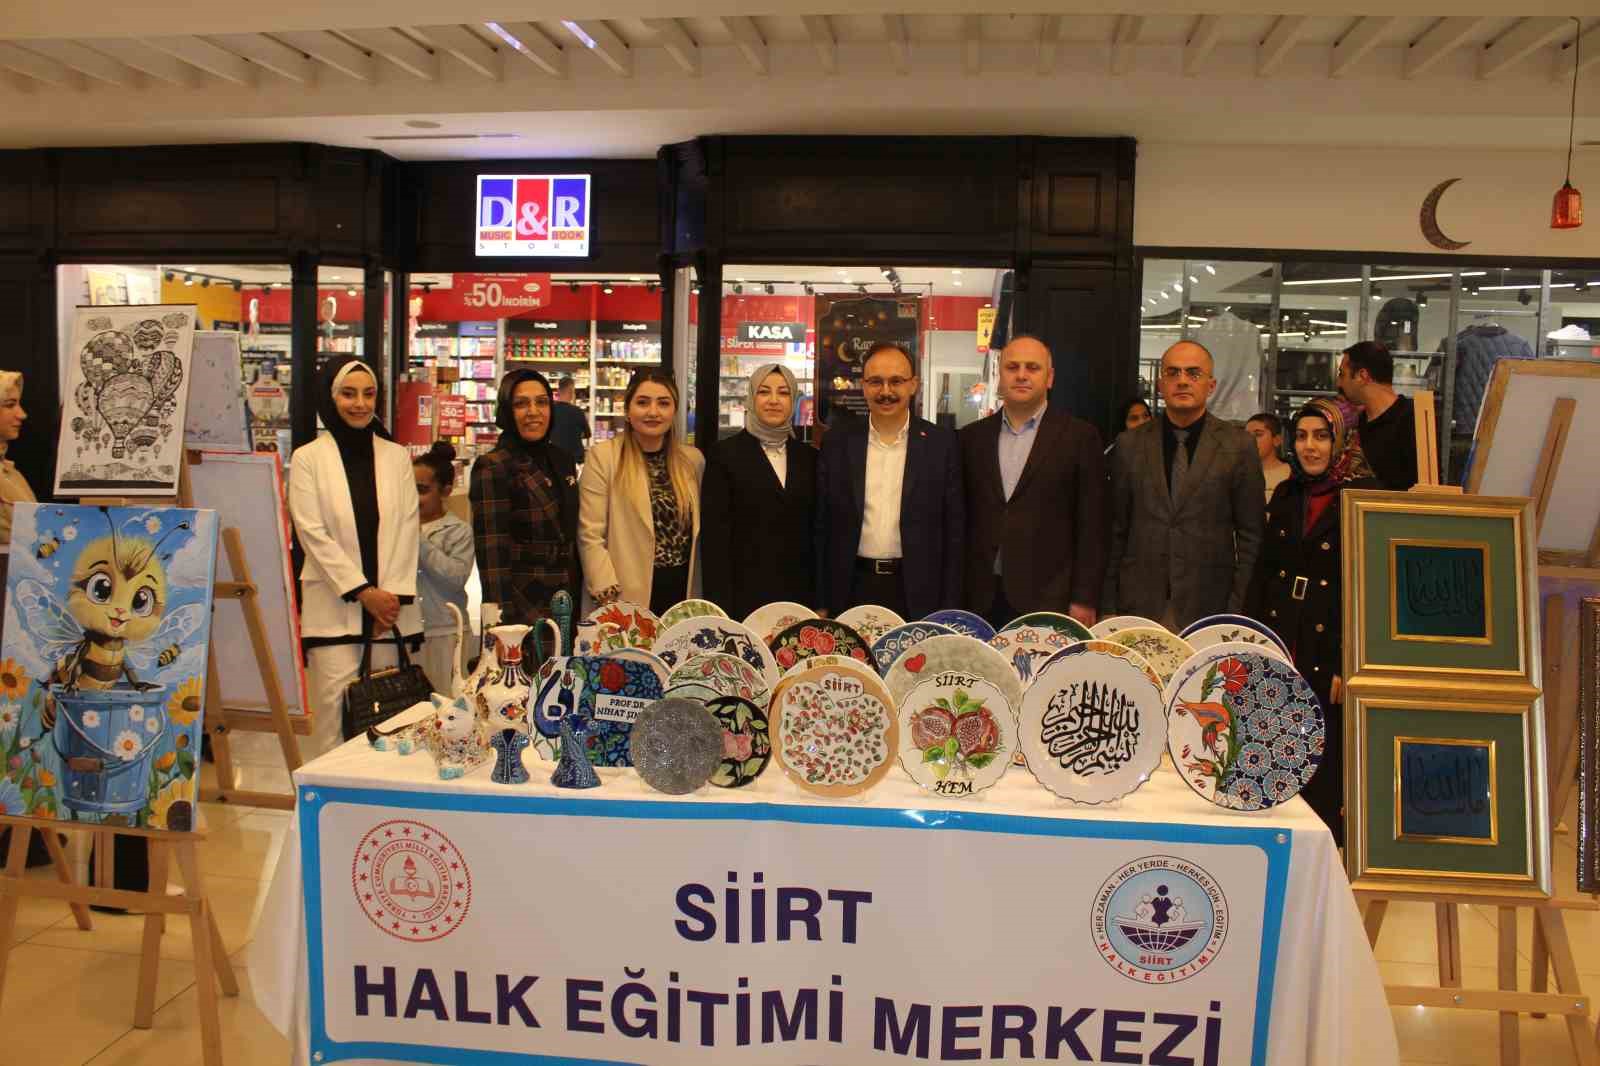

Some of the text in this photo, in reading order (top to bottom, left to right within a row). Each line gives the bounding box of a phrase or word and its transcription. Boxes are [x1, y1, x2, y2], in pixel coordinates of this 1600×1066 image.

[481, 196, 583, 236] D&R
[480, 231, 584, 240] MUSIC BOOK
[748, 325, 793, 339] KASA
[824, 677, 861, 694] SİİRT
[935, 780, 973, 794] HEM
[1098, 883, 1116, 914] ZAMAN
[1119, 866, 1137, 881] HER
[1138, 860, 1169, 871] YERDE
[1177, 863, 1210, 888] HERKES
[673, 871, 873, 945] SİİRT
[1099, 941, 1137, 977] HALK
[354, 965, 1222, 1066] HALK EĞİTİMİ MERKEZİ
